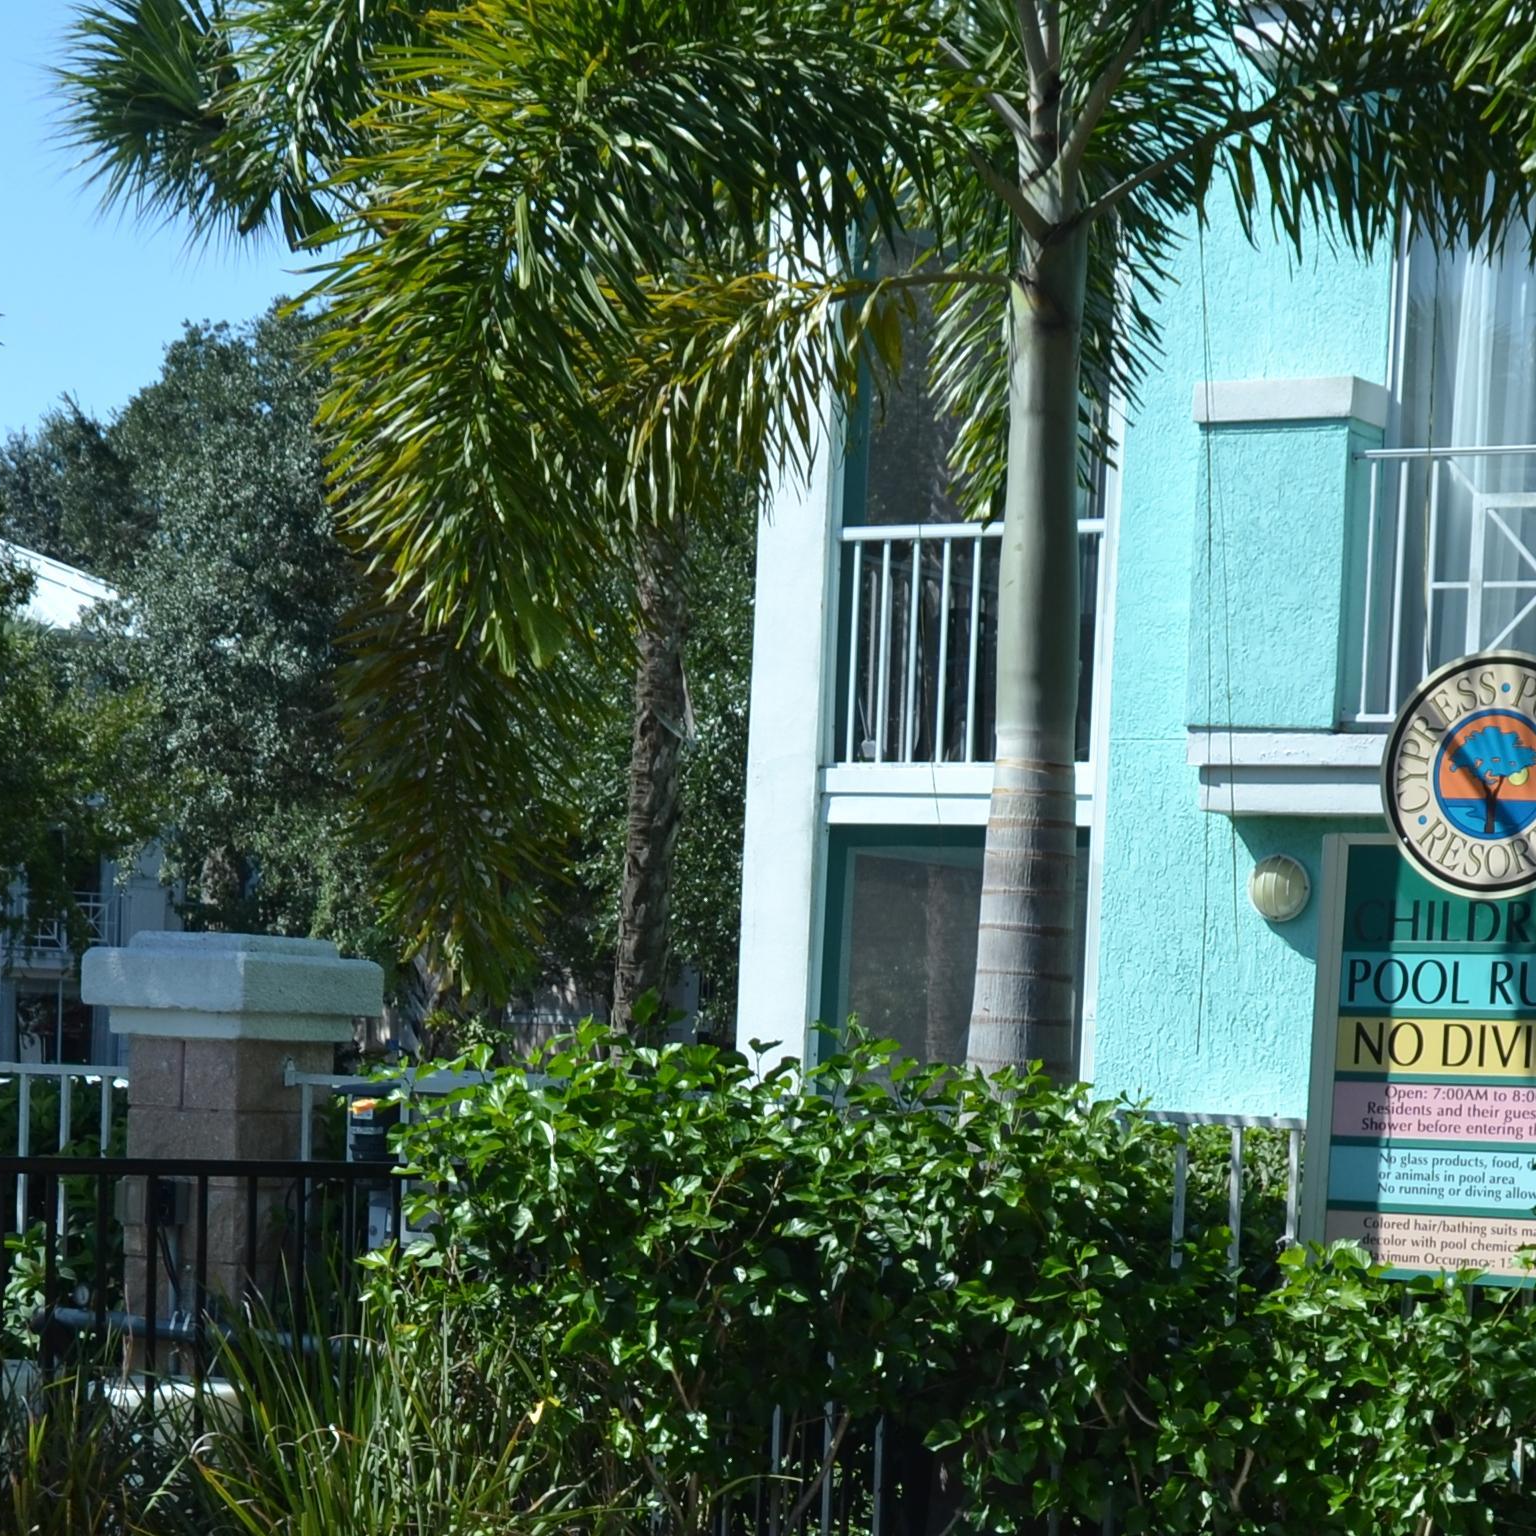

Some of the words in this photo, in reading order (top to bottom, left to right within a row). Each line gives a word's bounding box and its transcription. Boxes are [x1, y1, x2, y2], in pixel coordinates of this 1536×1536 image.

[1397, 671, 1497, 814] CYPRESS
[1348, 957, 1469, 1005] POOL
[1353, 1021, 1424, 1067] NO
[1385, 1085, 1428, 1102] Open:
[1433, 1087, 1489, 1101] 7:00AM
[1493, 1090, 1507, 1102] to
[1367, 1101, 1432, 1117] Residents
[1437, 1104, 1463, 1117] and
[1467, 1104, 1500, 1118] their
[1361, 1117, 1413, 1132] Shower
[1417, 1119, 1462, 1134] before
[1466, 1123, 1523, 1140] entering
[1379, 1152, 1397, 1164] No
[1400, 1152, 1429, 1168] glass
[1432, 1154, 1488, 1170] products,
[1492, 1155, 1523, 1171] food,
[1378, 1171, 1391, 1180] or
[1394, 1168, 1440, 1182] animals
[1444, 1170, 1455, 1182] in
[1459, 1171, 1485, 1186] pool
[1489, 1174, 1515, 1185] area
[1377, 1182, 1395, 1194] No
[1399, 1183, 1445, 1199] running
[1448, 1187, 1461, 1196] or
[1465, 1185, 1502, 1201] diving
[1363, 1217, 1411, 1231] Colored
[1414, 1218, 1487, 1238] hair/bathing
[1490, 1223, 1518, 1237] suits
[1362, 1232, 1406, 1247] decolor
[1411, 1235, 1437, 1248] with
[1440, 1237, 1467, 1252] pool
